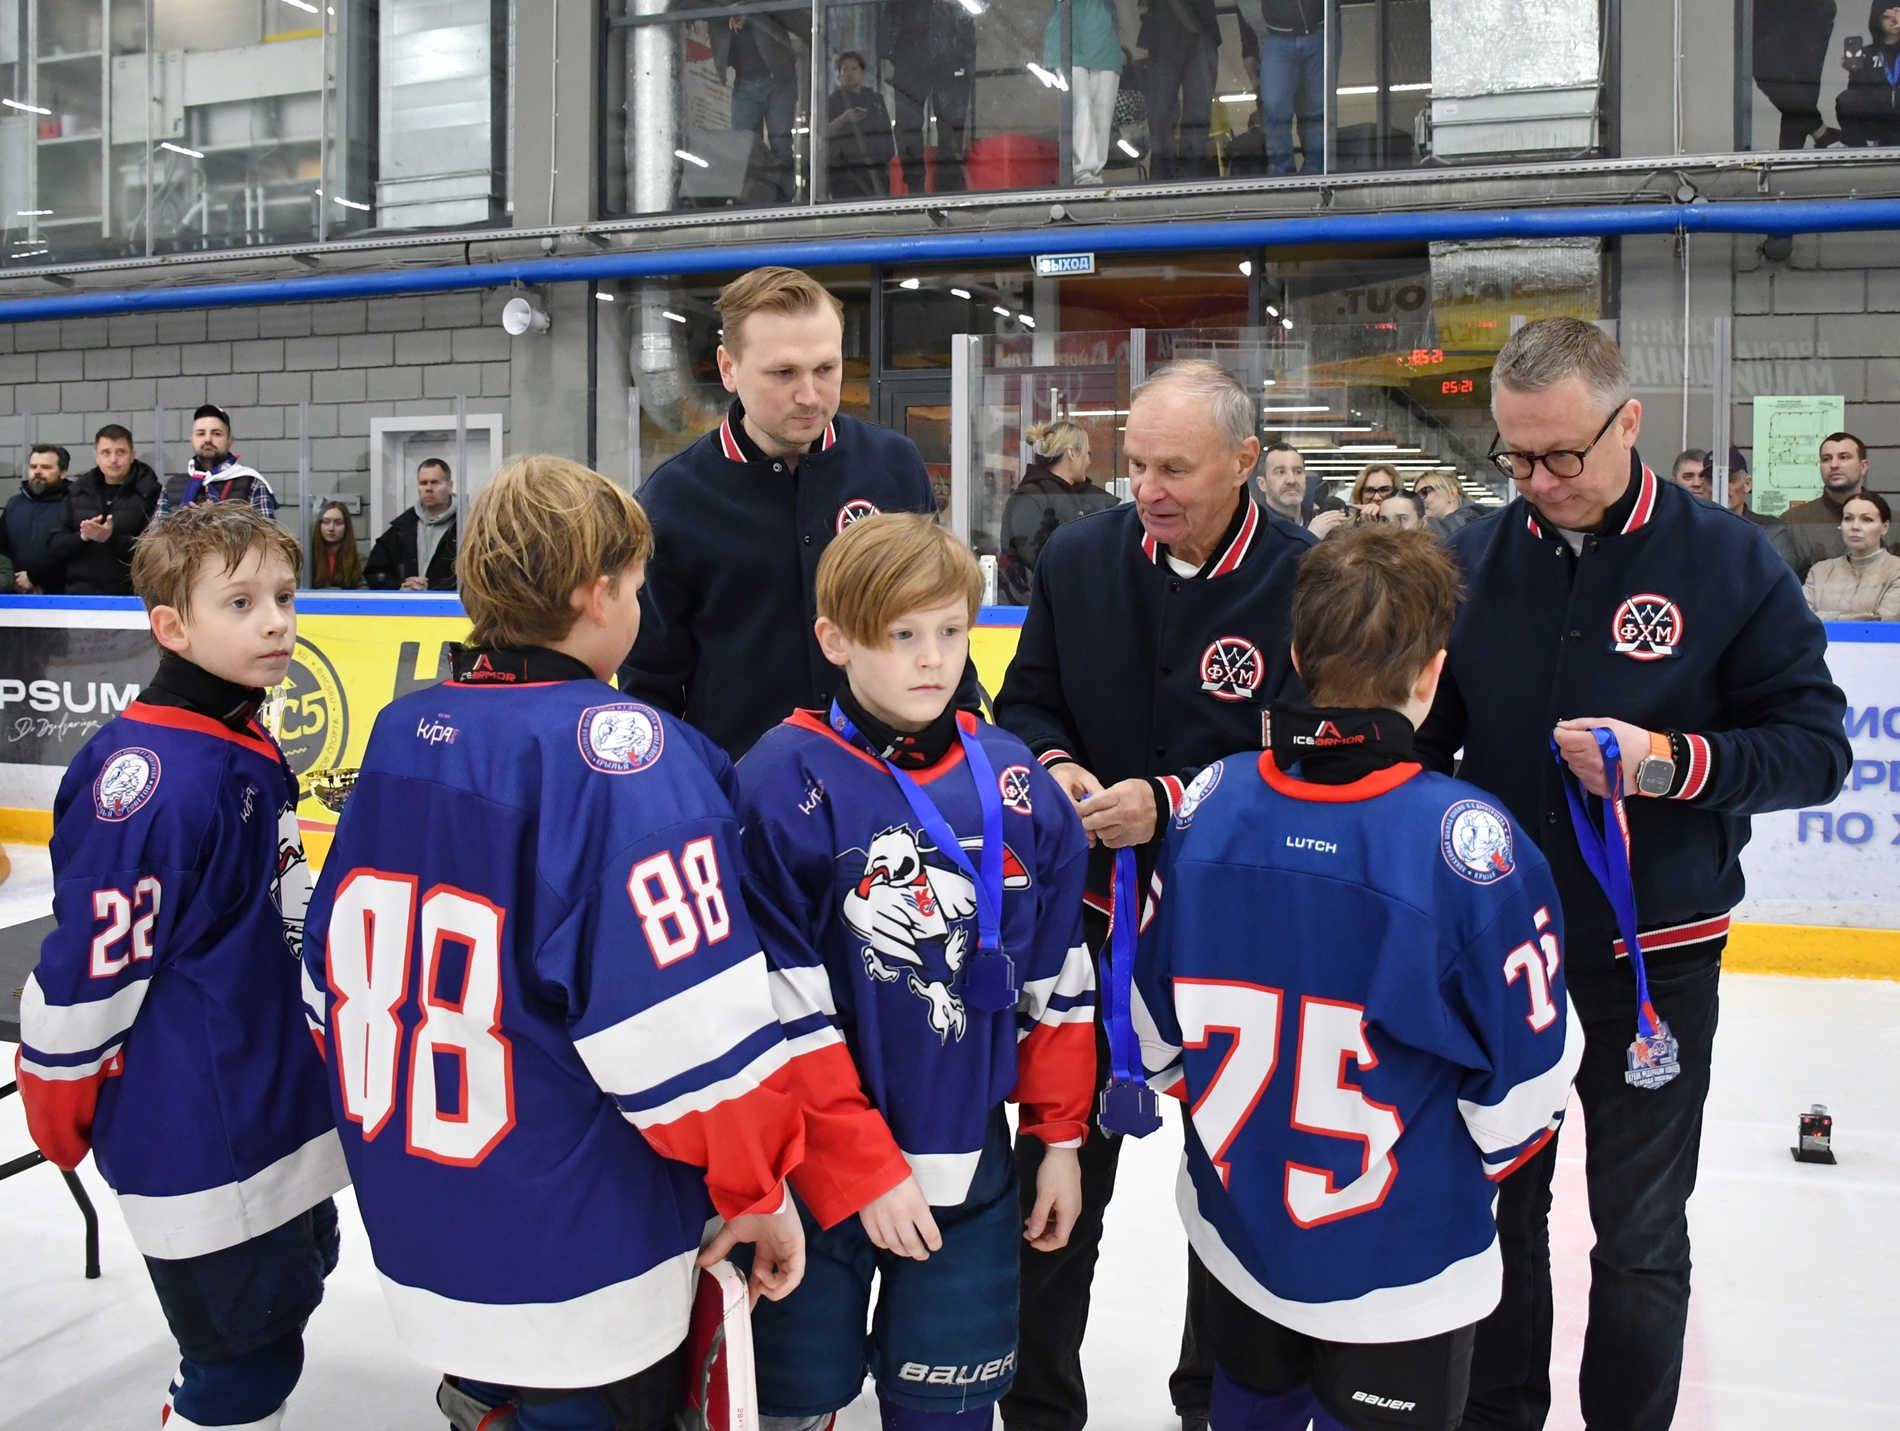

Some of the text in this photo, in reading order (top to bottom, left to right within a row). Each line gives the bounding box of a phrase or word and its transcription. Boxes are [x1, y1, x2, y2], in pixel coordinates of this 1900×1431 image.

[1041, 257, 1089, 272] ВЫХОД
[1620, 623, 1672, 643] ФХМ
[1207, 664, 1254, 686] ФХМ
[1006, 784, 1030, 800] ФХ
[1798, 811, 1874, 845] ПО
[1286, 835, 1337, 854] LUTCH
[627, 836, 731, 969] 88
[89, 873, 162, 979] 22
[325, 867, 517, 1168] 88
[1173, 976, 1405, 1230] 75
[898, 1350, 1016, 1386] BAUER
[1351, 1390, 1416, 1412] BAUER
